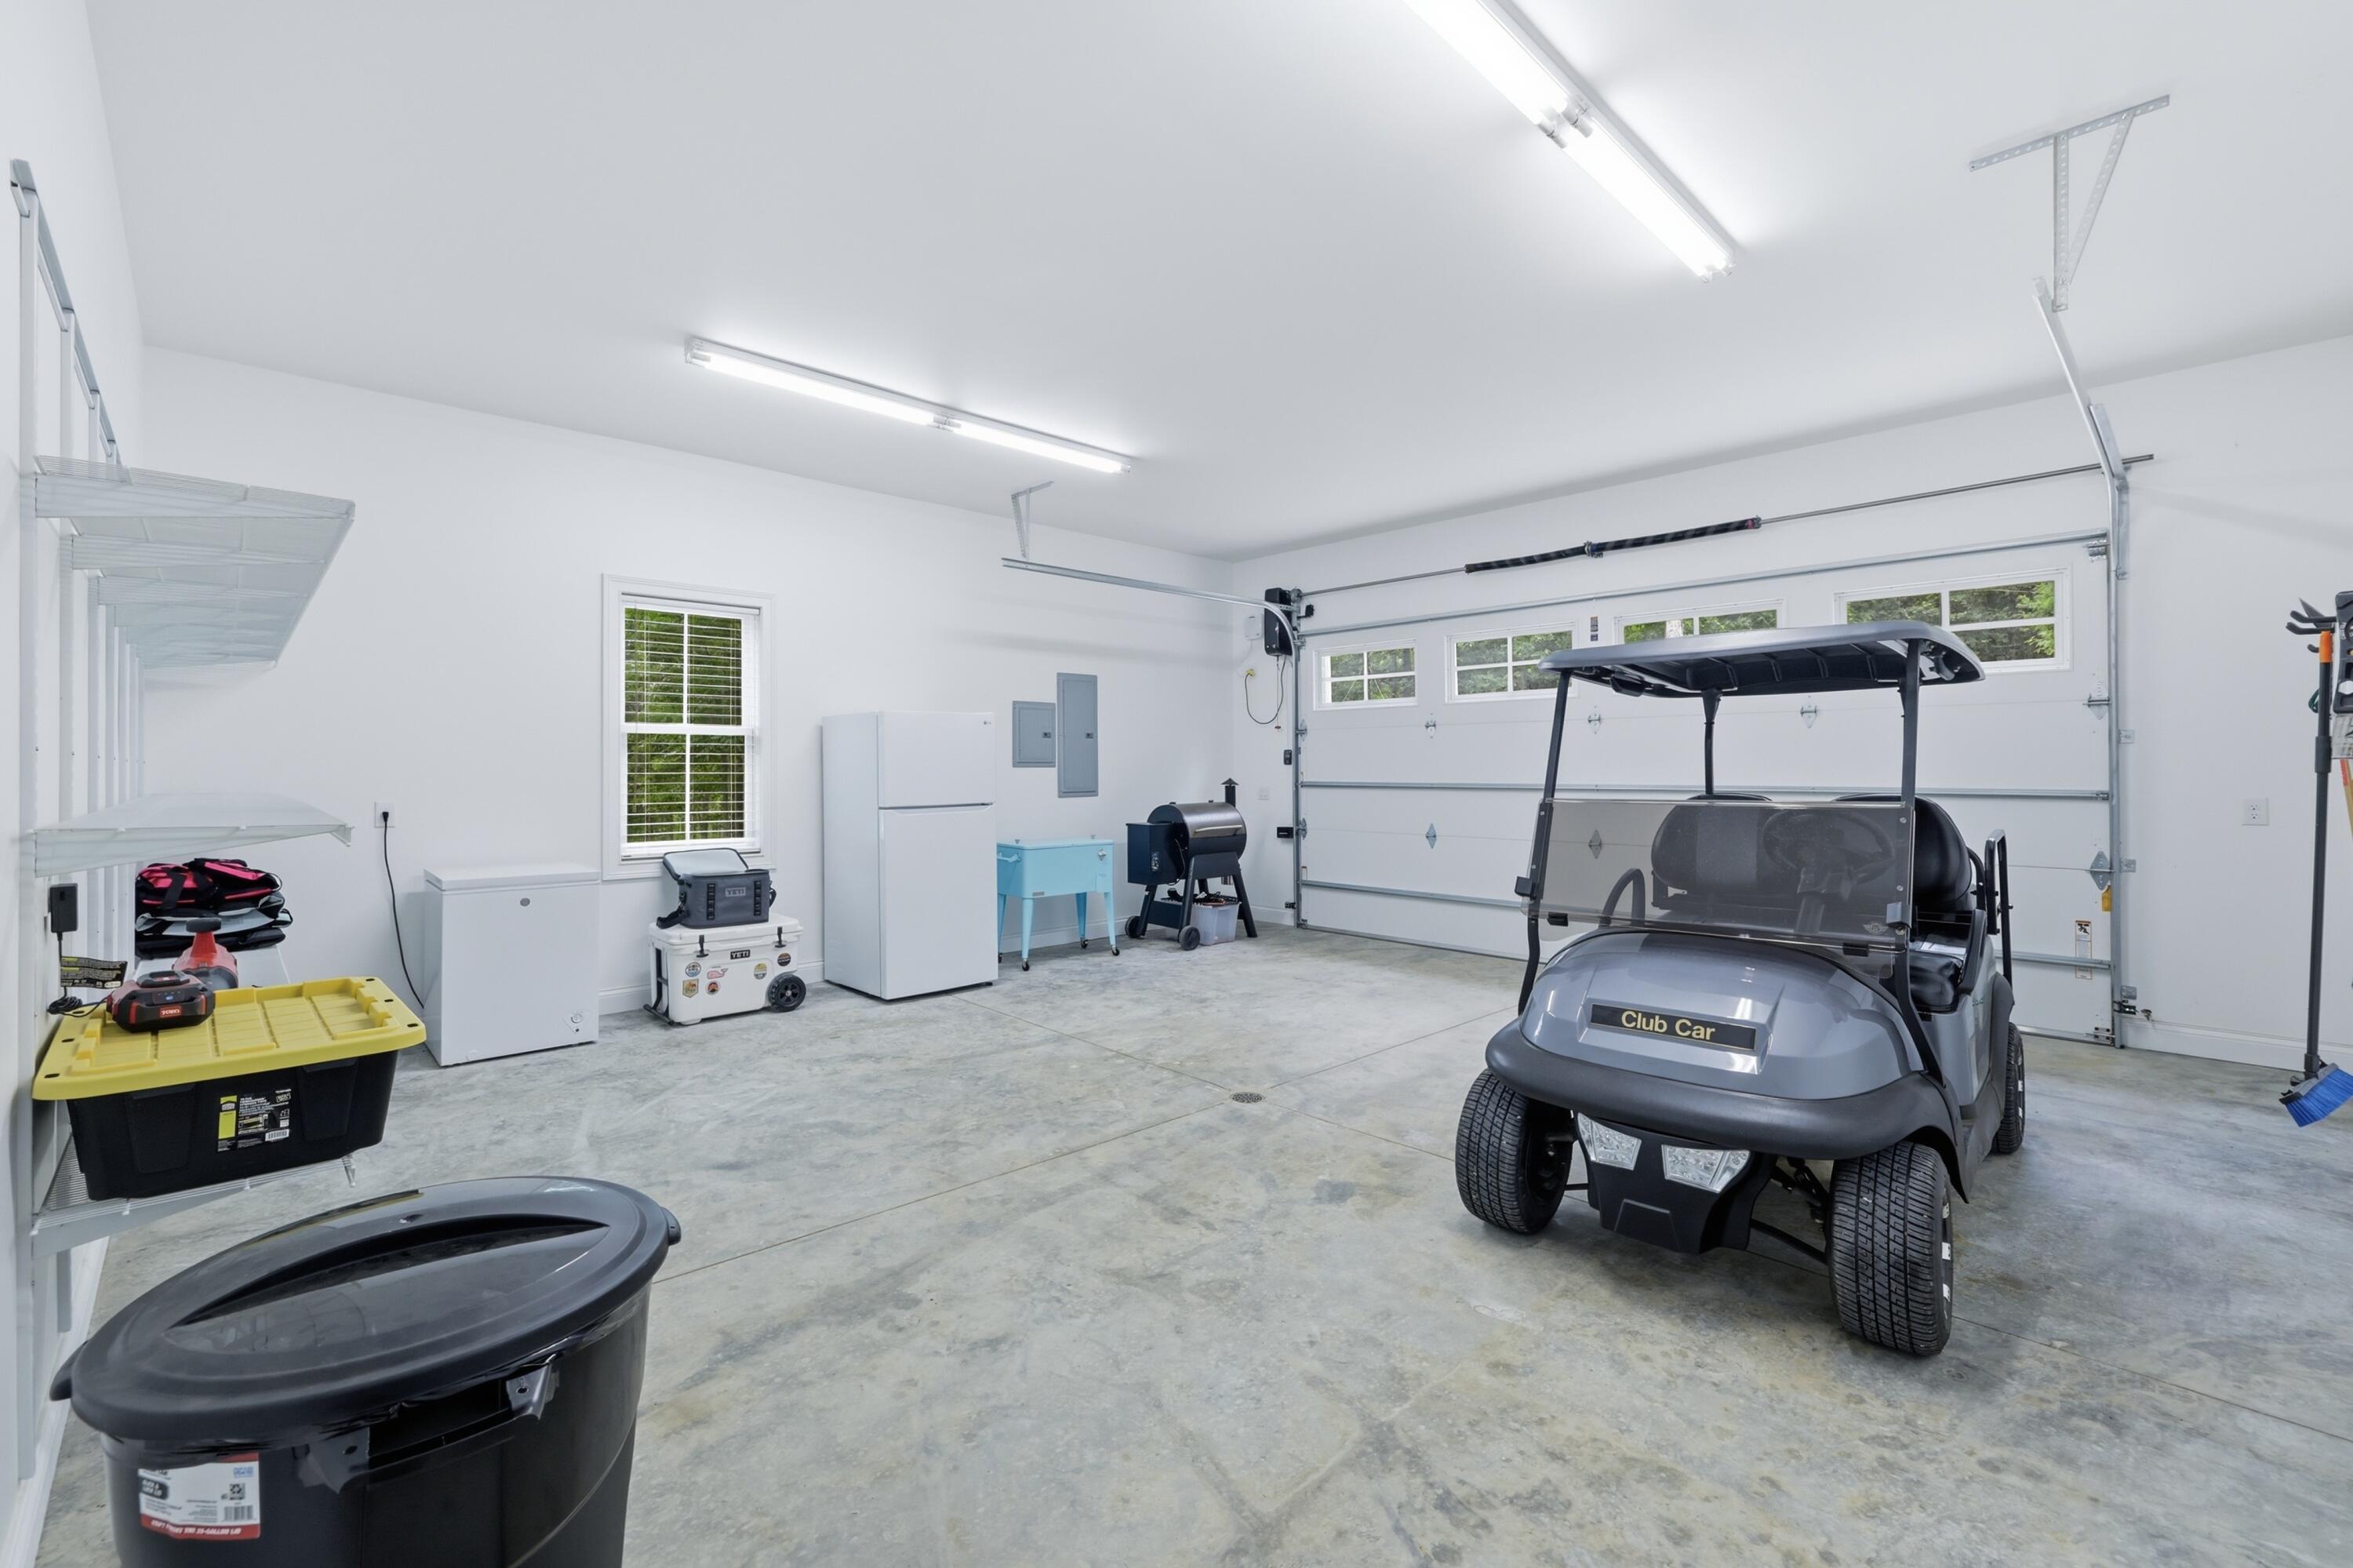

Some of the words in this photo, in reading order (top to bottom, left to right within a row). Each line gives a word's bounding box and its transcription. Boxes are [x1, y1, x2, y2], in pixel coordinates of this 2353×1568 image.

[731, 951, 749, 959] YETI
[1621, 1010, 1667, 1032] Club
[1675, 1019, 1715, 1040] Car
